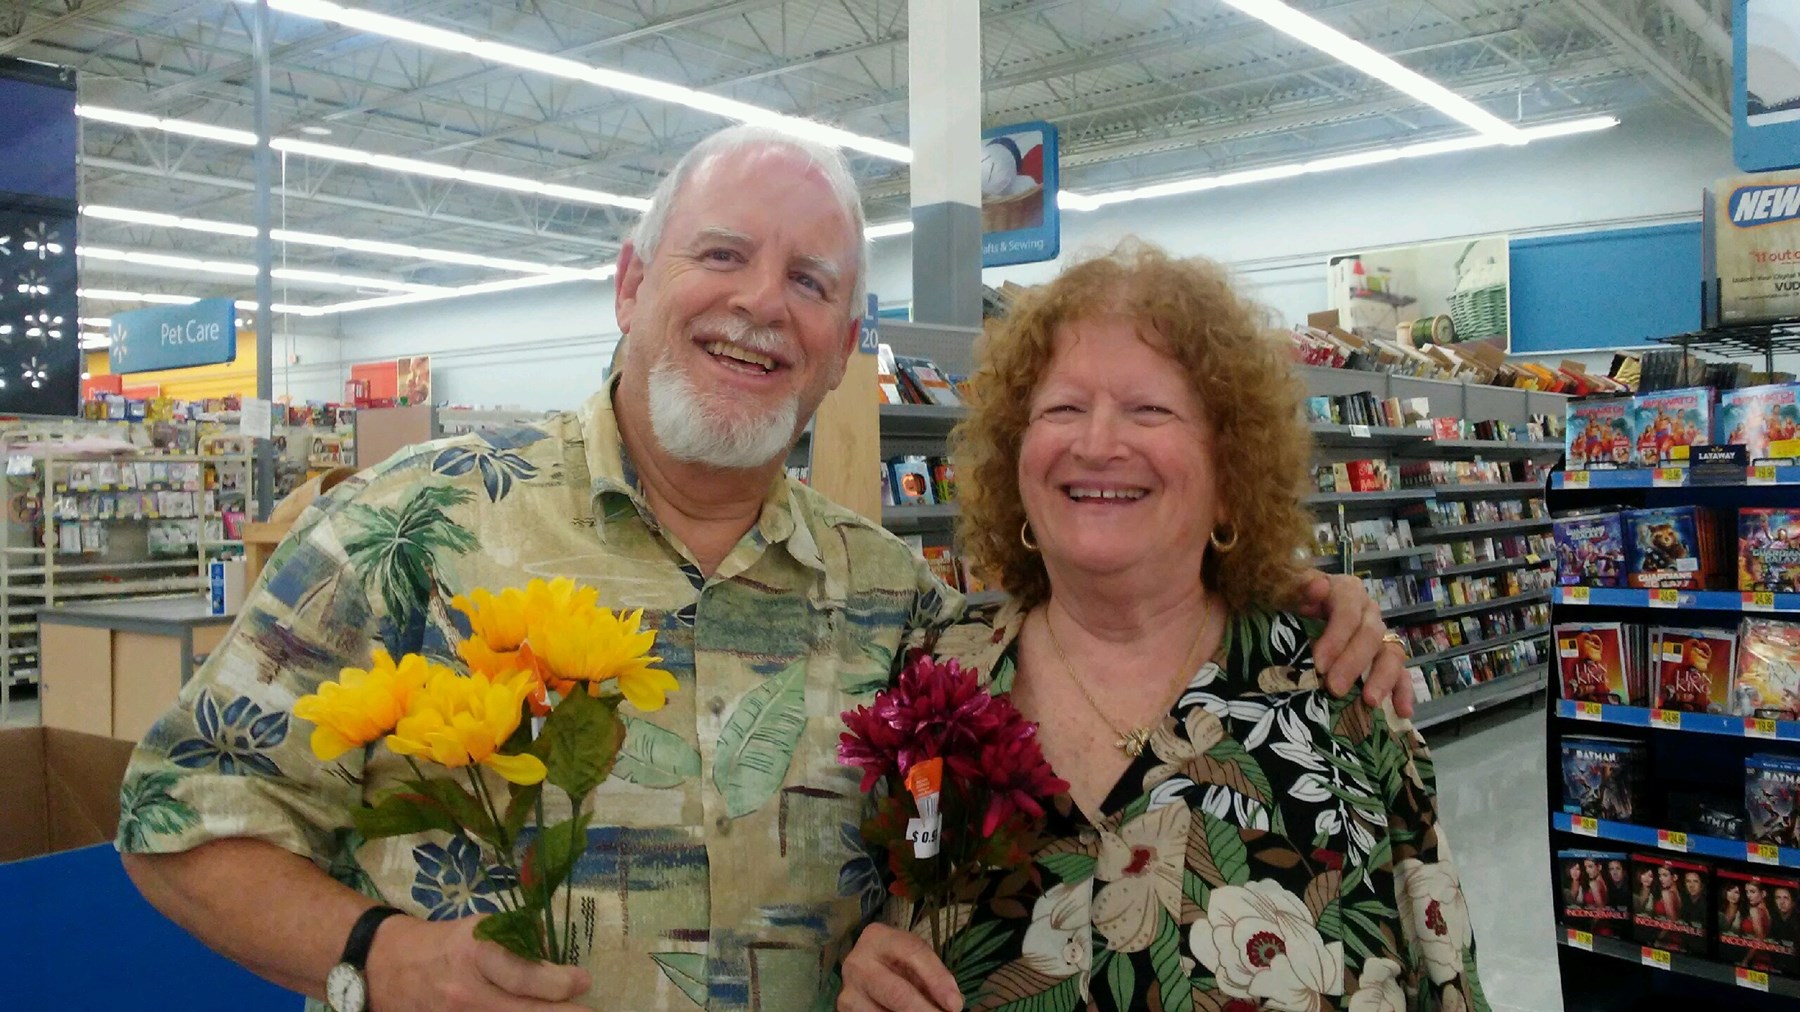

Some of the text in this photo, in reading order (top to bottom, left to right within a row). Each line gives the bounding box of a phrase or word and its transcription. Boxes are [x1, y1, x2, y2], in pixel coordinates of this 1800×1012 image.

[1733, 186, 1800, 222] NEW
[982, 239, 1044, 255] afts & Sewing
[1768, 249, 1792, 262] out
[1775, 281, 1800, 292] VUD
[161, 318, 220, 346] Pet Care
[862, 328, 878, 349] 20
[1698, 451, 1736, 460] LAYAWAY
[1753, 548, 1800, 559] GUARDIAN
[1576, 750, 1616, 762] BATMAN
[1763, 770, 1800, 784] BATMA
[1699, 815, 1736, 831] ATMAN
